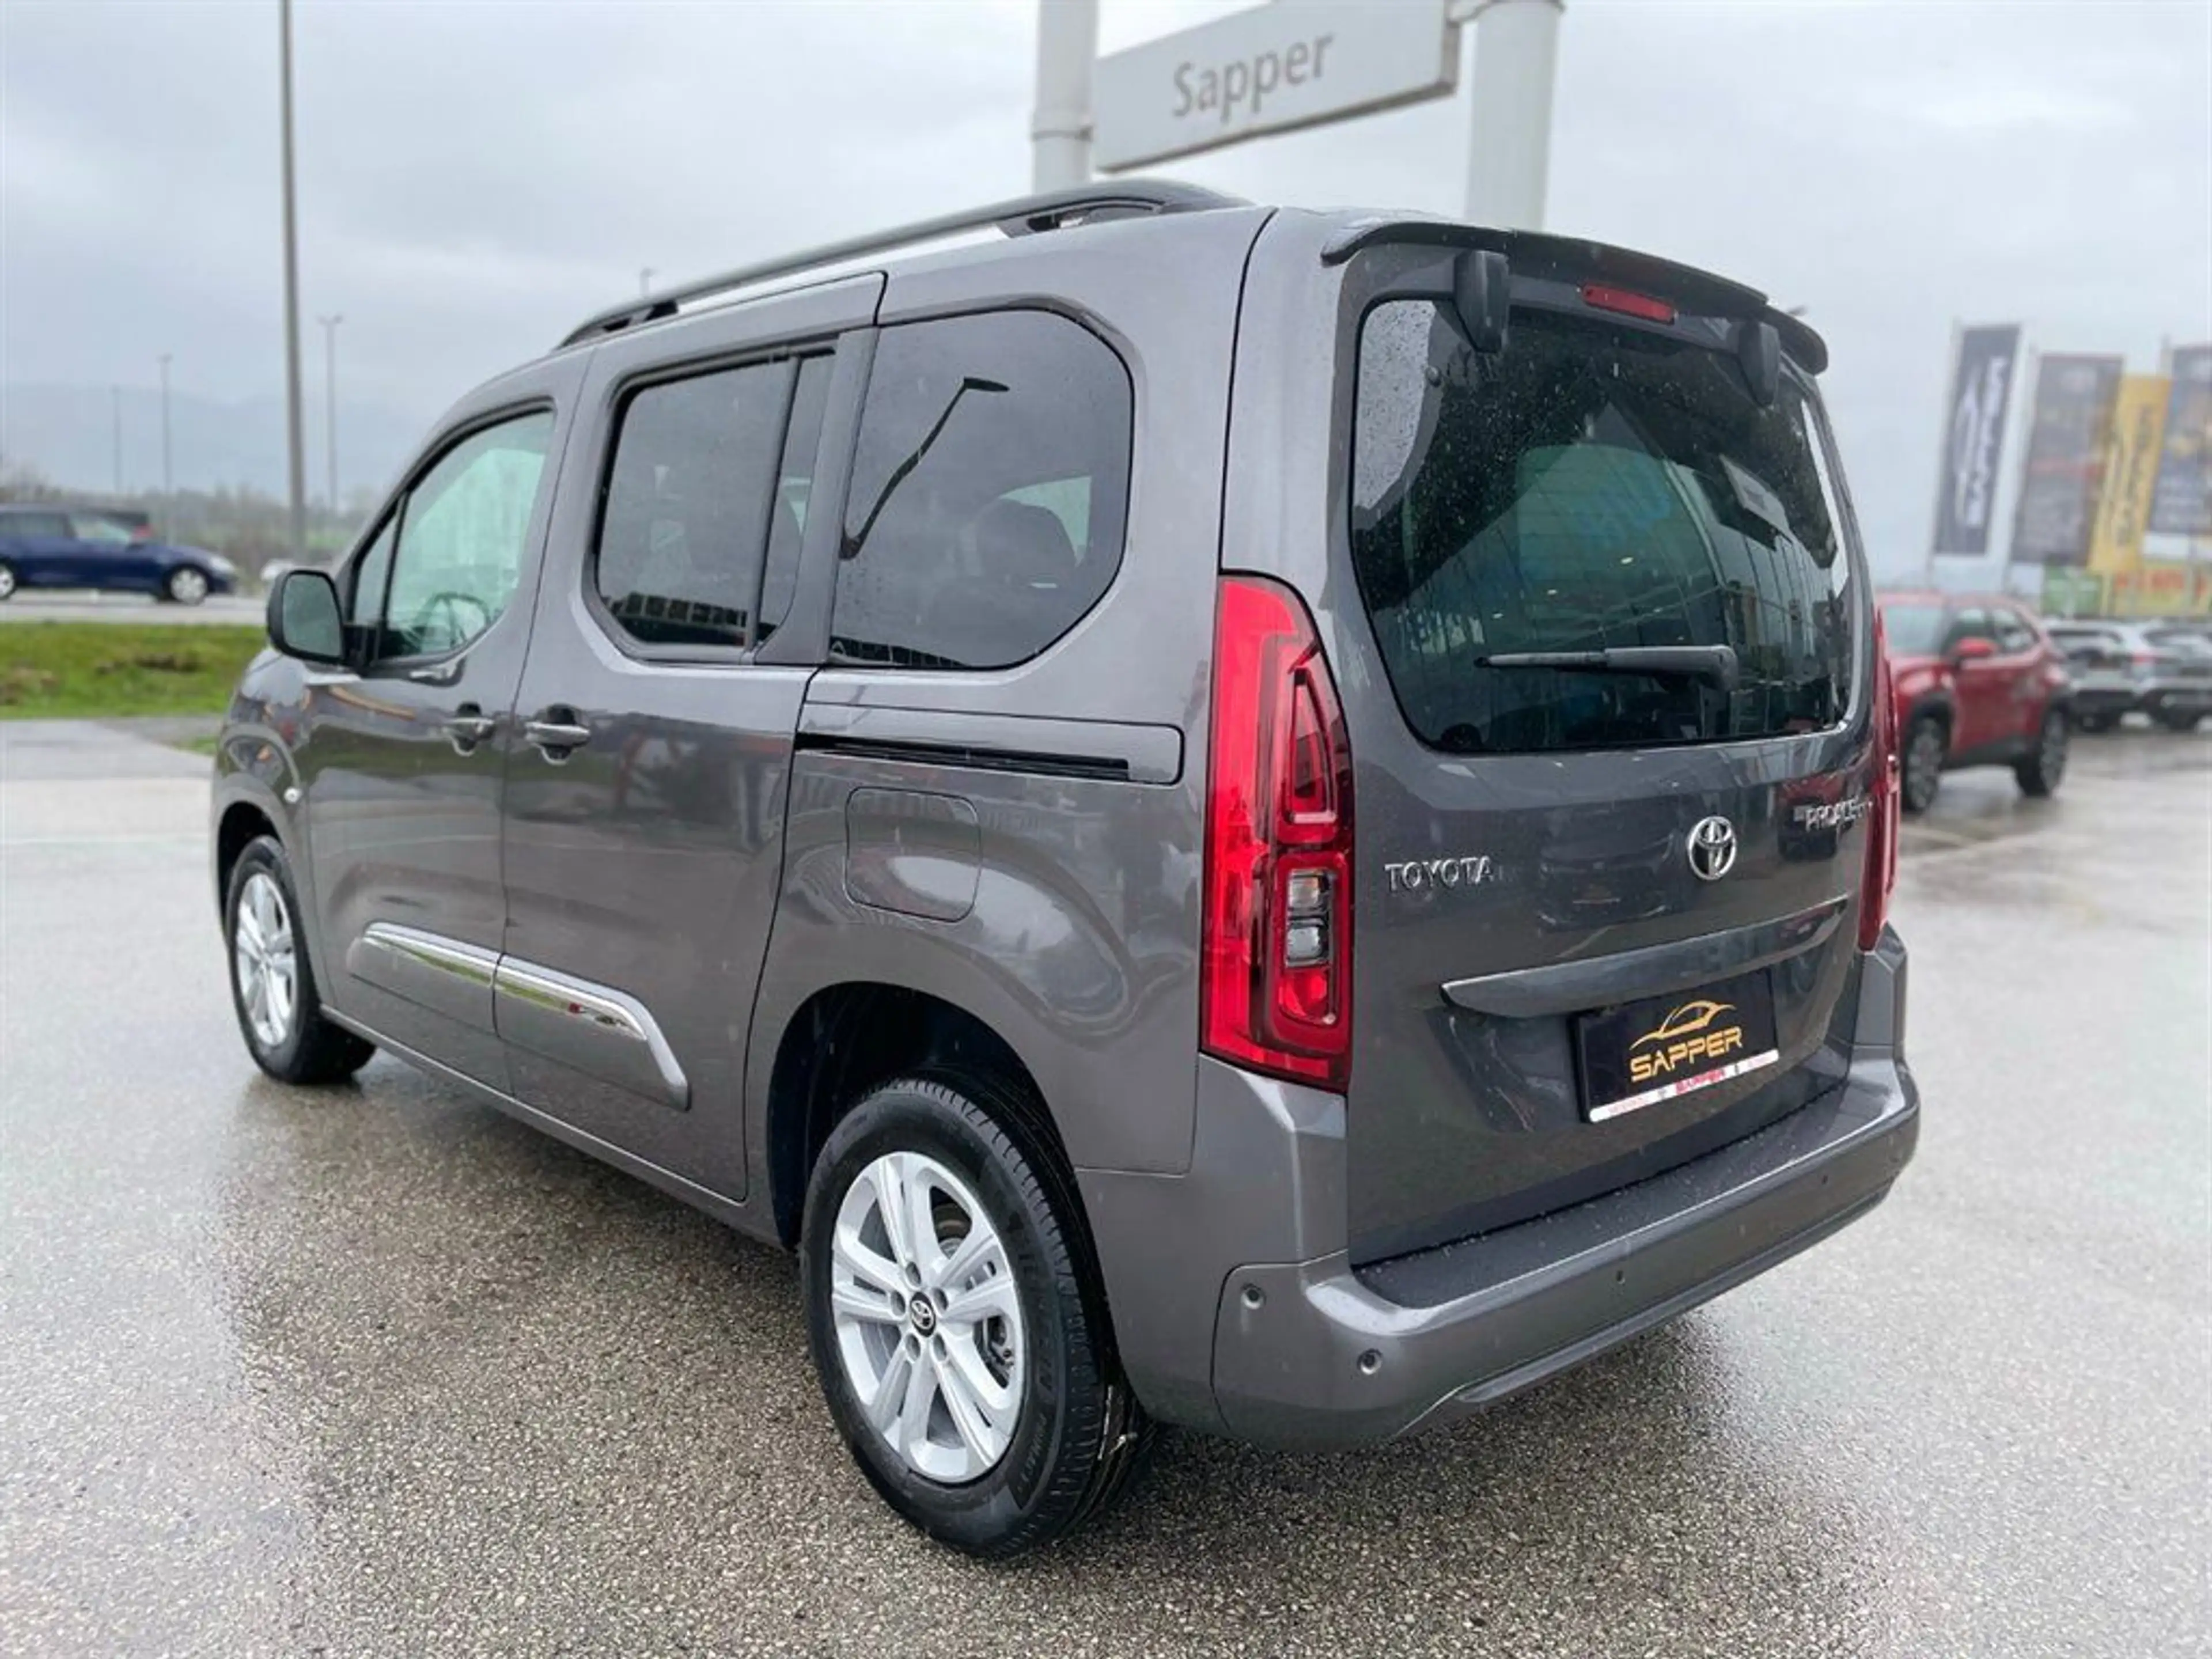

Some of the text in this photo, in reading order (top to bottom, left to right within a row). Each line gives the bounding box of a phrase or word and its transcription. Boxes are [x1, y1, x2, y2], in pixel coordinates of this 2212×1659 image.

[1173, 33, 1334, 123] Sapper
[1384, 855, 1495, 891] TOYOTA
[1630, 1026, 1743, 1082] SAPPER
